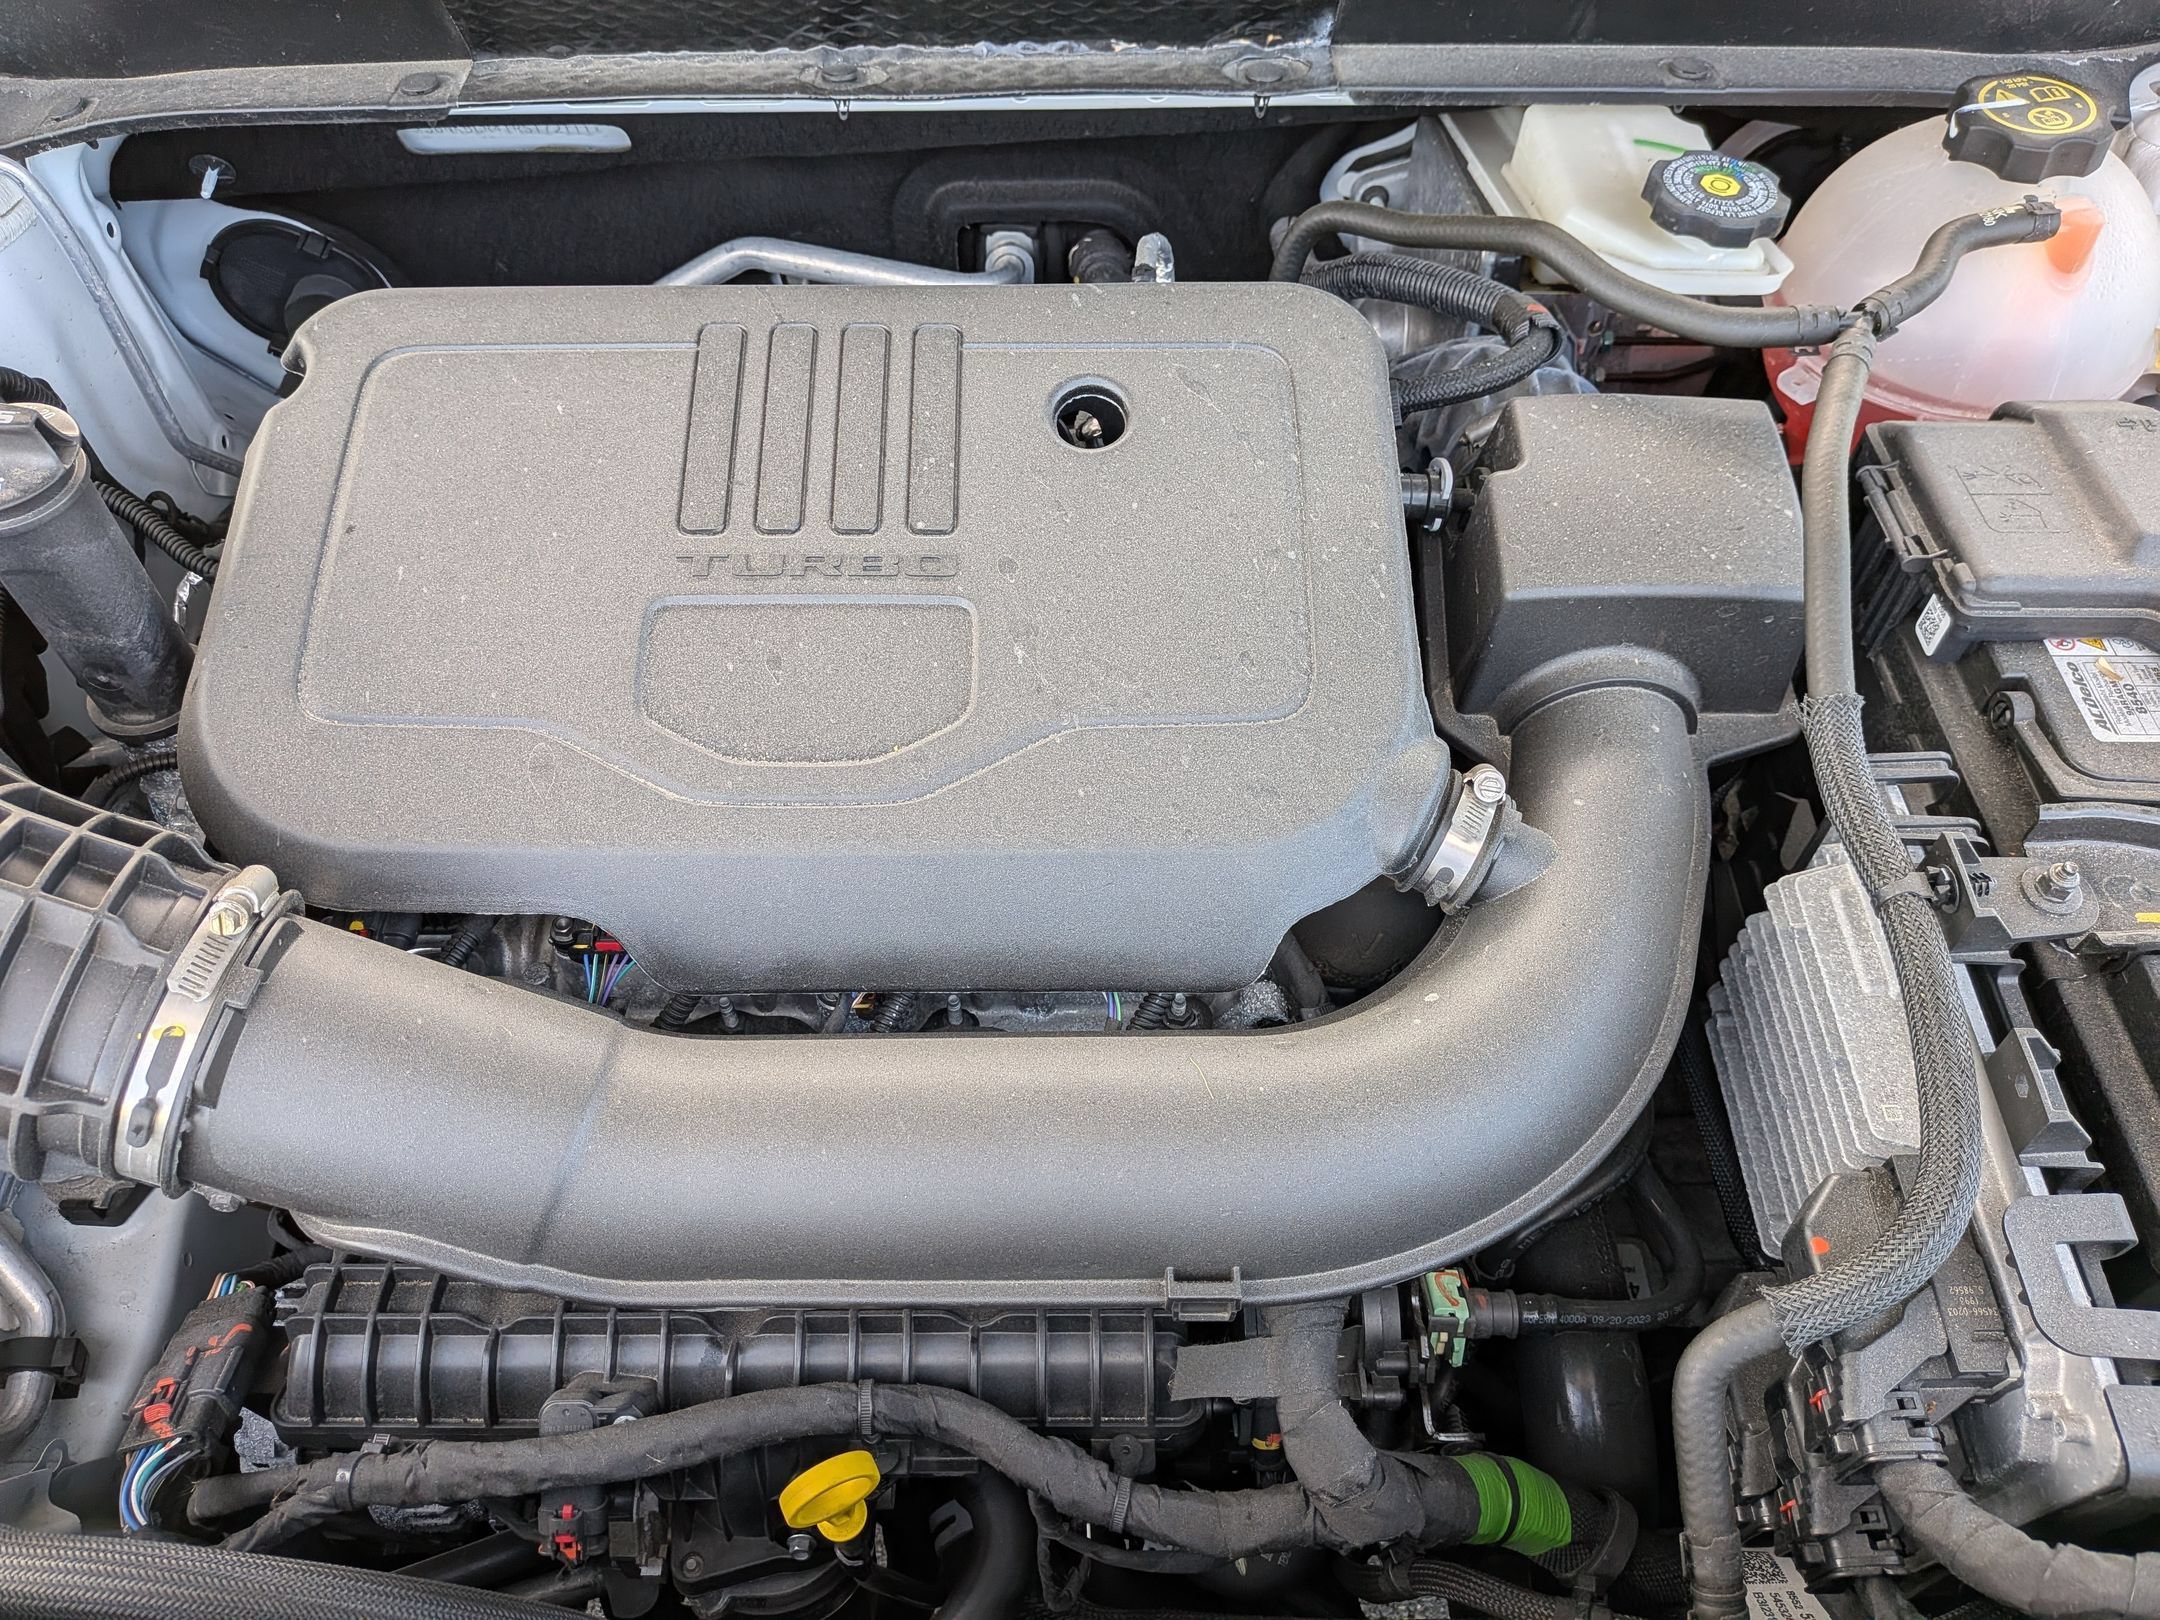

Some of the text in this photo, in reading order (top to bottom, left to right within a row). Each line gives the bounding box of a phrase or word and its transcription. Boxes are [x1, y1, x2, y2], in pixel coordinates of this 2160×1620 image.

[675, 554, 961, 579] TURBO
[2066, 662, 2112, 732] ACDelco
[2122, 683, 2148, 715] 8540
[1591, 1313, 1651, 1325] 09/20/2023
[1769, 1592, 1793, 1620] 54532
